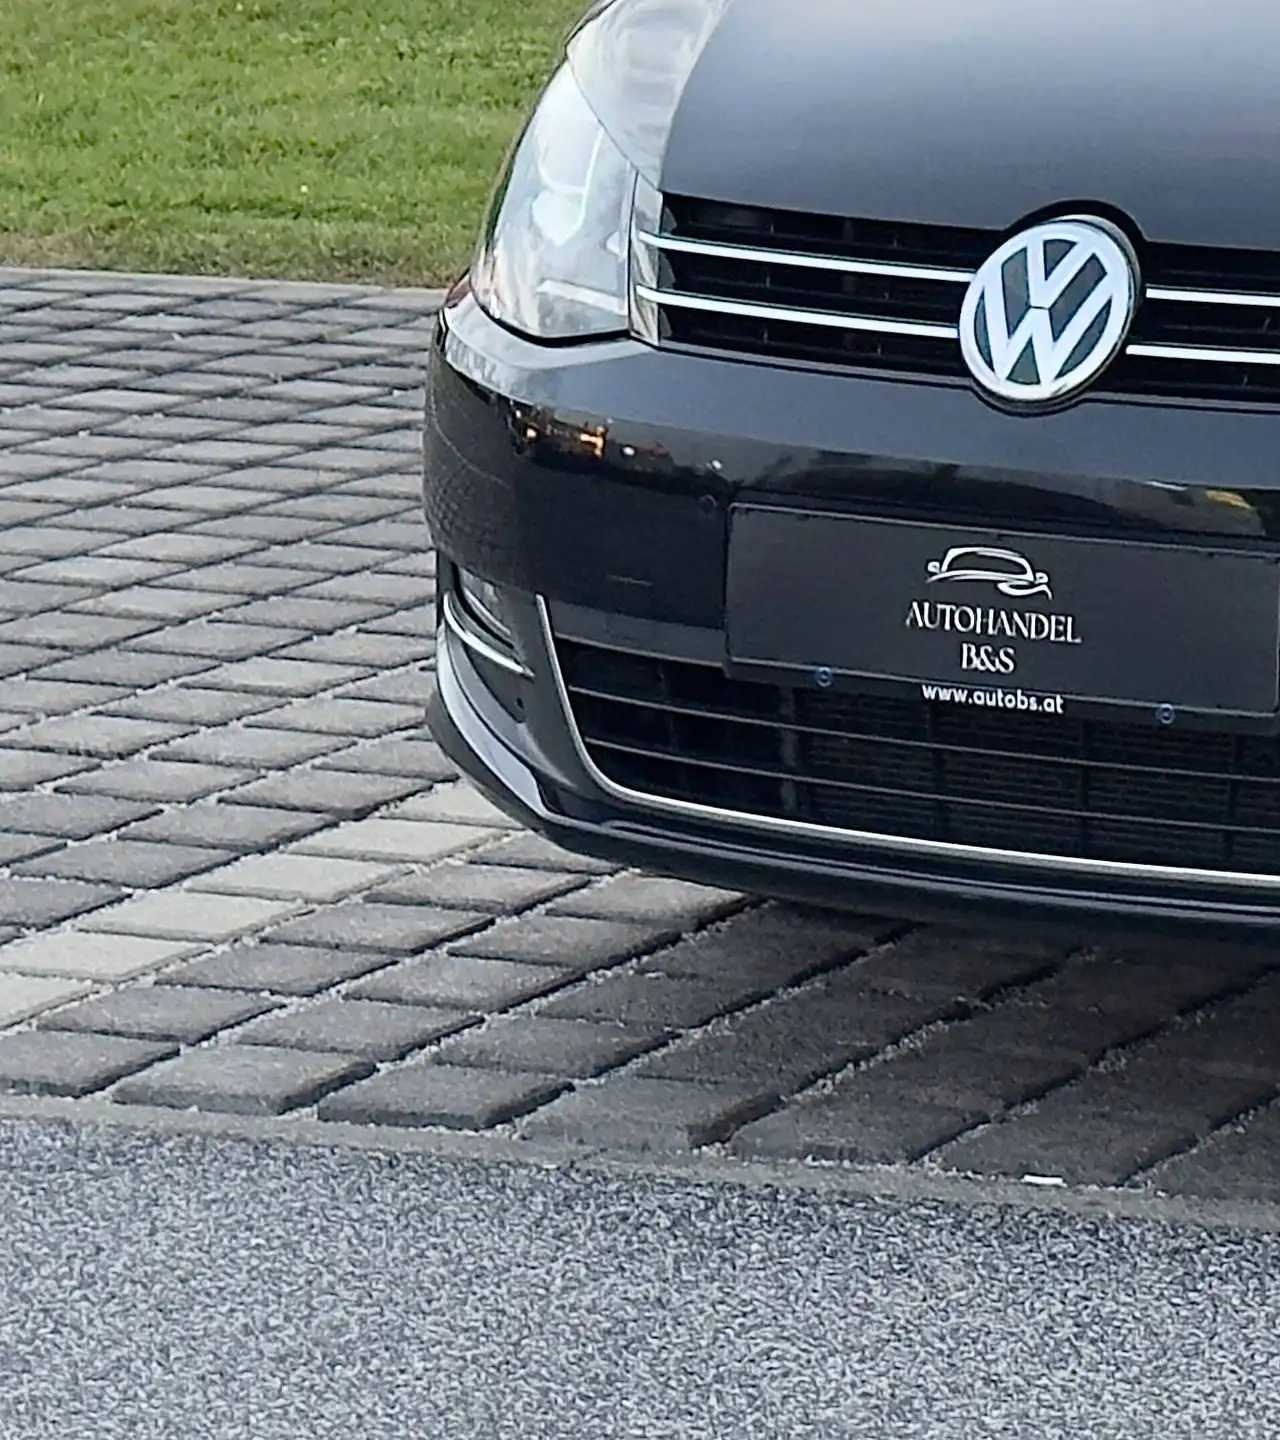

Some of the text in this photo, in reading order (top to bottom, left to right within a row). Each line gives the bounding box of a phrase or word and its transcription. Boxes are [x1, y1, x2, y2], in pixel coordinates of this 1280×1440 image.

[905, 601, 1082, 644] AUTOHANDEL
[961, 642, 1016, 674] B&S
[921, 683, 1065, 714] www.autobs.at
